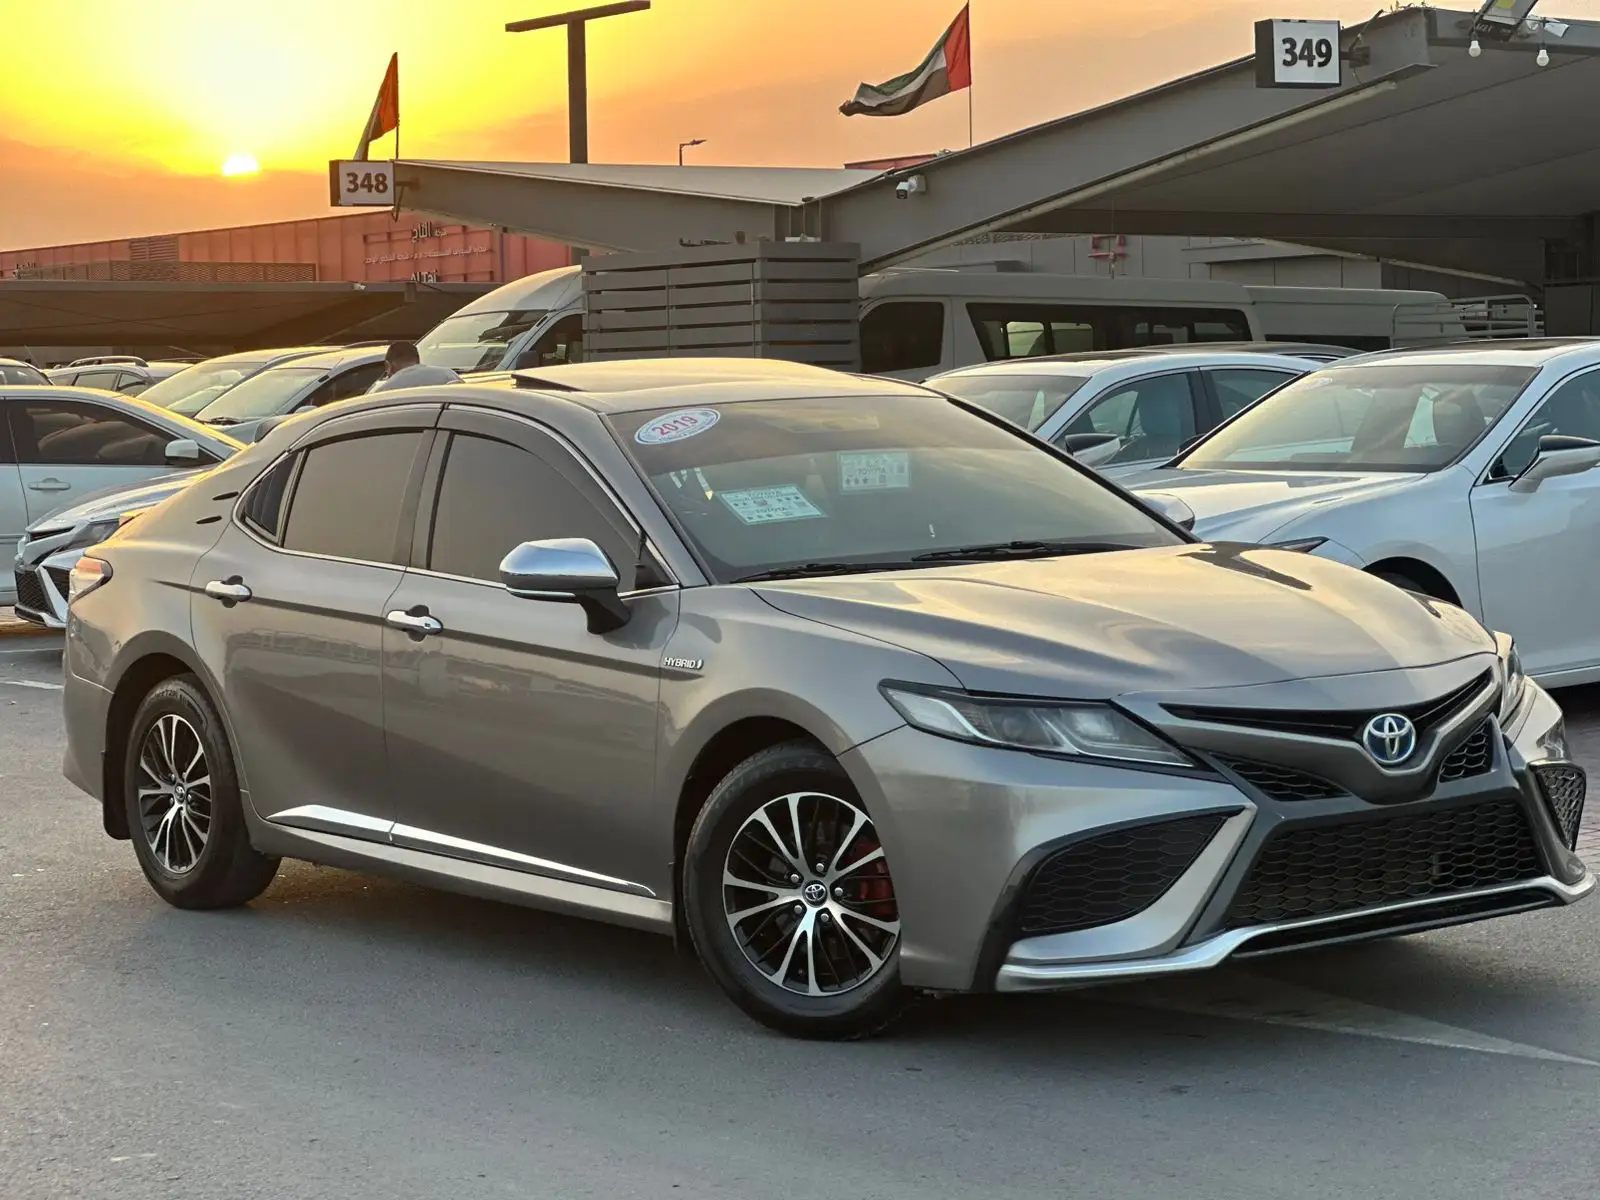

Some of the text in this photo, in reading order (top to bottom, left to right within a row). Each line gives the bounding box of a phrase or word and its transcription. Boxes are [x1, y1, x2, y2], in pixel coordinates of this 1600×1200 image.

[1281, 37, 1333, 68] 349
[345, 171, 388, 194] 348
[411, 220, 431, 243] التاج
[652, 415, 698, 436] 2019
[664, 656, 696, 669] HYBRID
